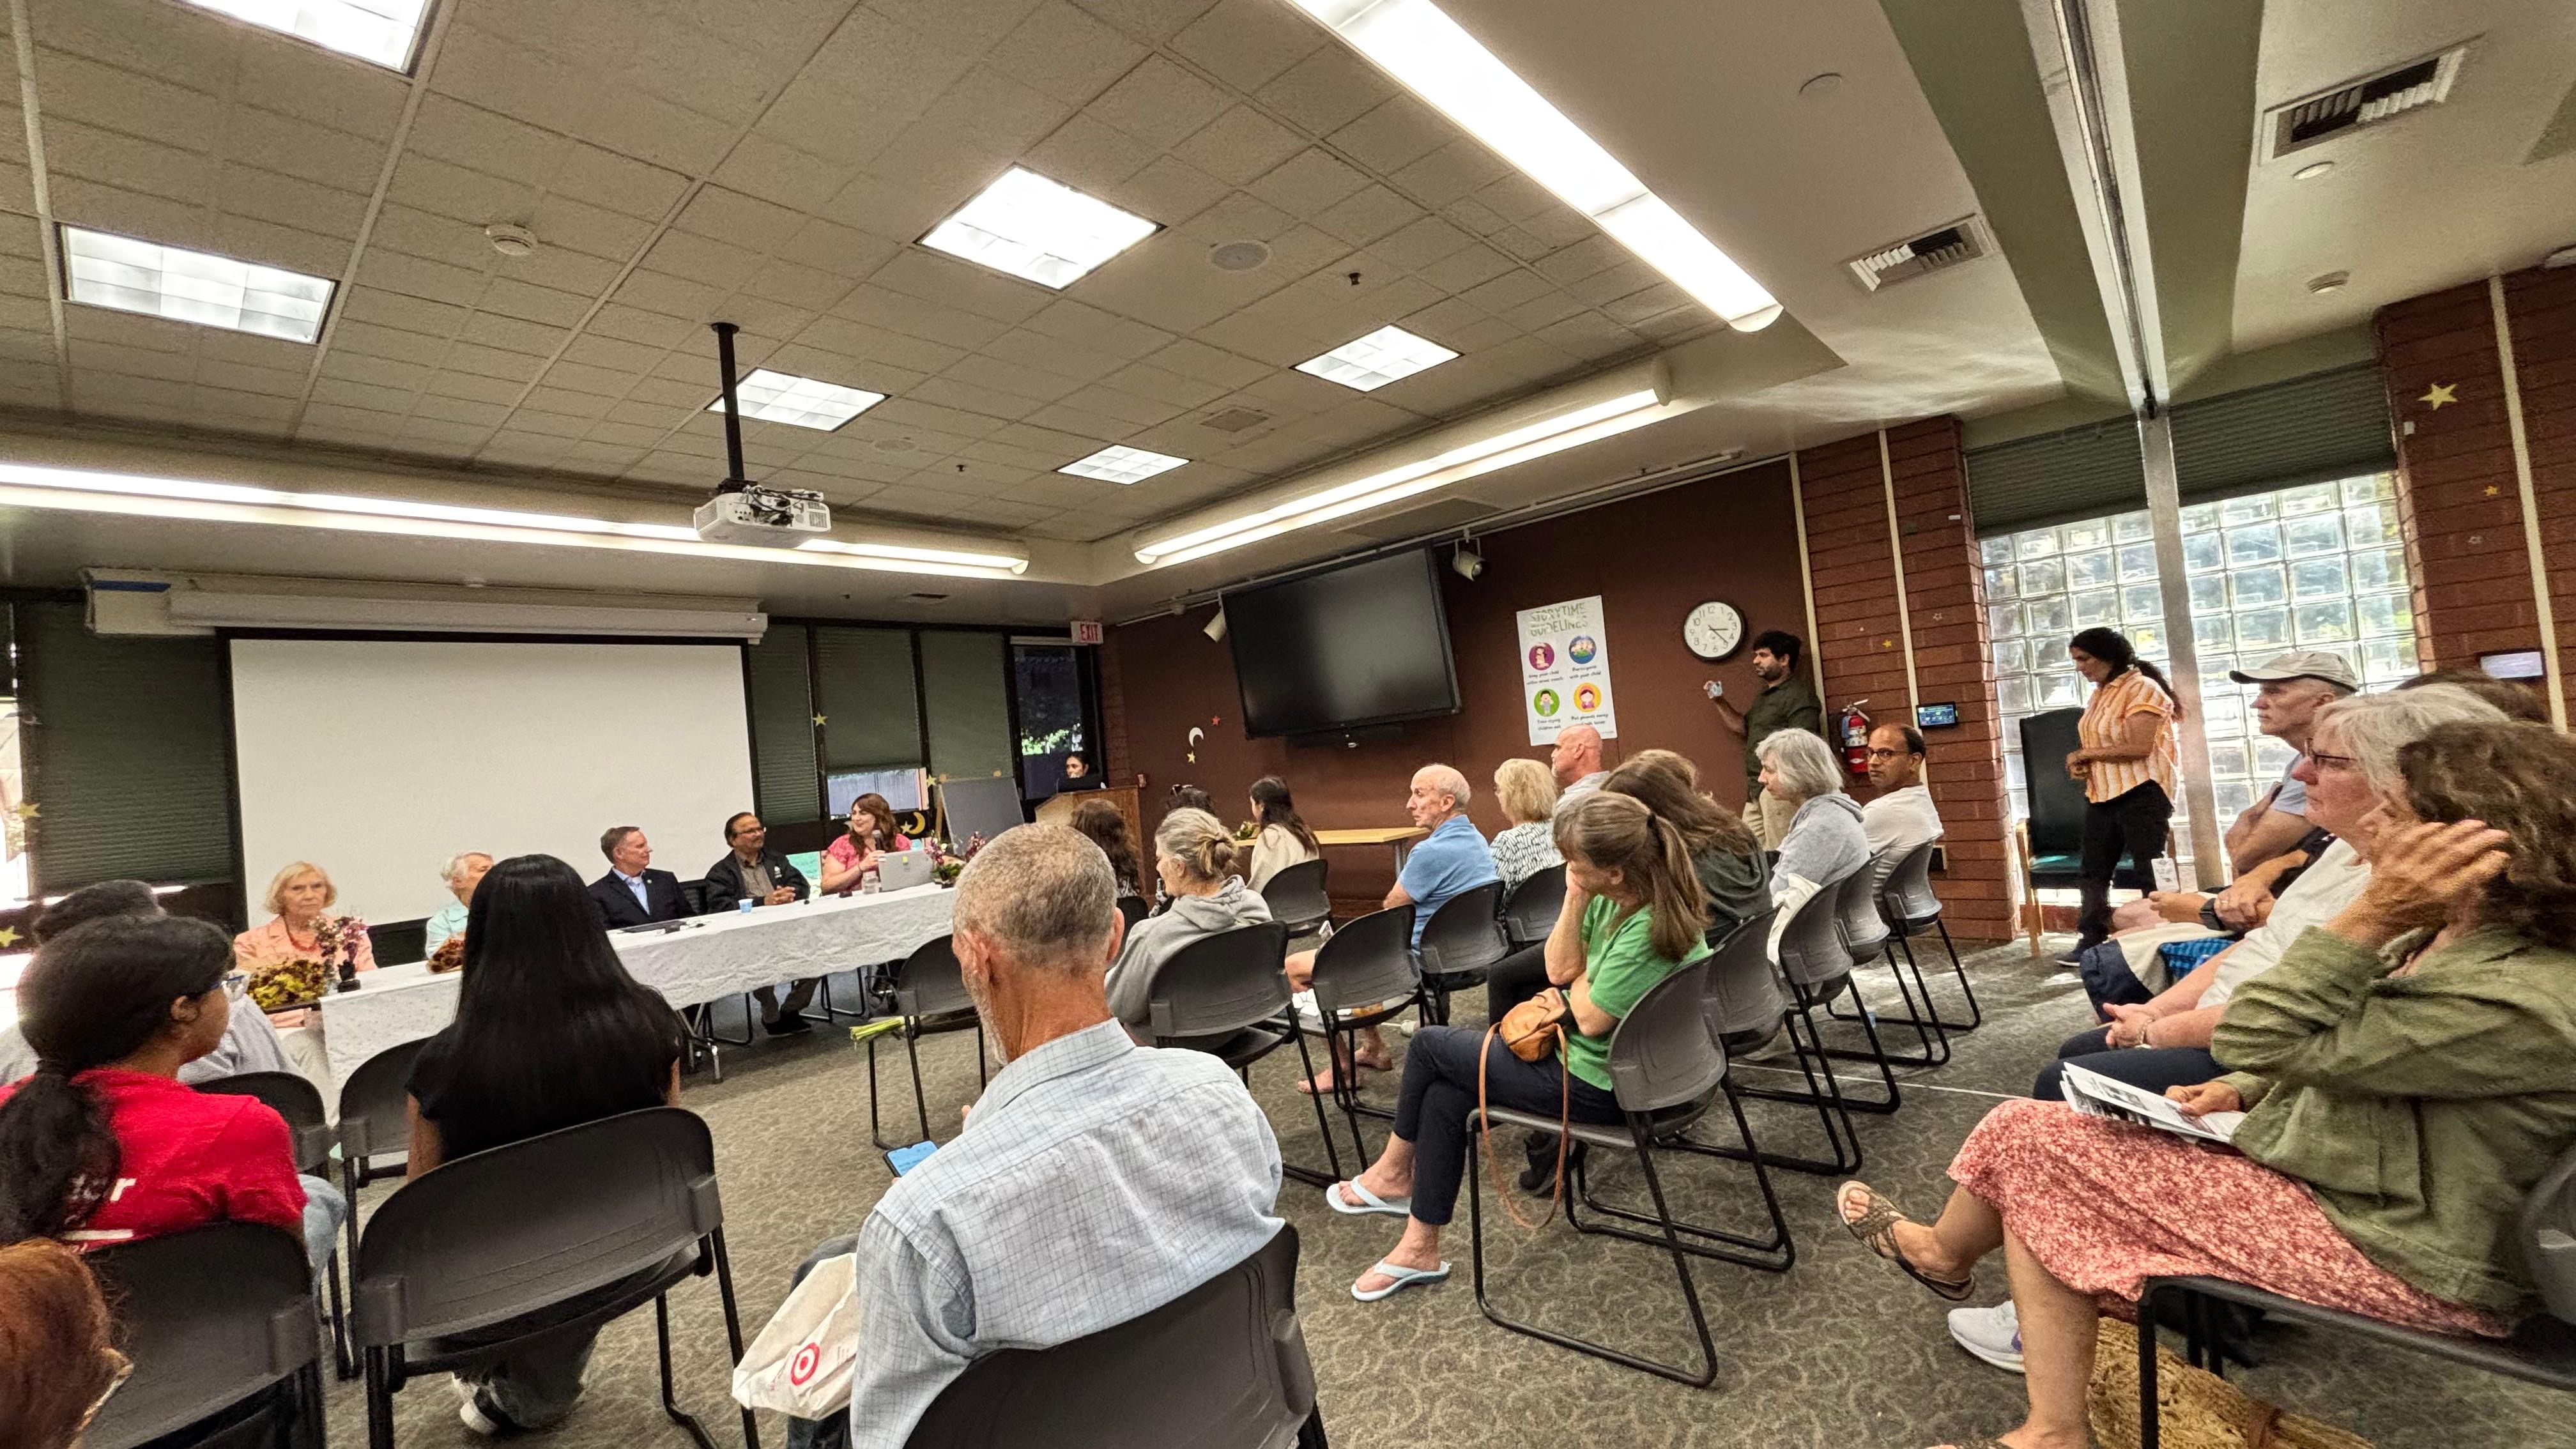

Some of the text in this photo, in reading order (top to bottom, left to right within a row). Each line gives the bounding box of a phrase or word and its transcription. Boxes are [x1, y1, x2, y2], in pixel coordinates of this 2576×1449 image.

[1530, 602, 1586, 622] STORYTIME
[1699, 610, 1705, 618] 11
[1707, 605, 1715, 614] 12
[1728, 612, 1734, 620] 2
[1530, 615, 1589, 637] GUIDELINES
[1692, 618, 1701, 626] 10
[1732, 622, 1737, 631] 3
[1080, 624, 1098, 641] EXIT
[1694, 637, 1699, 645] 8
